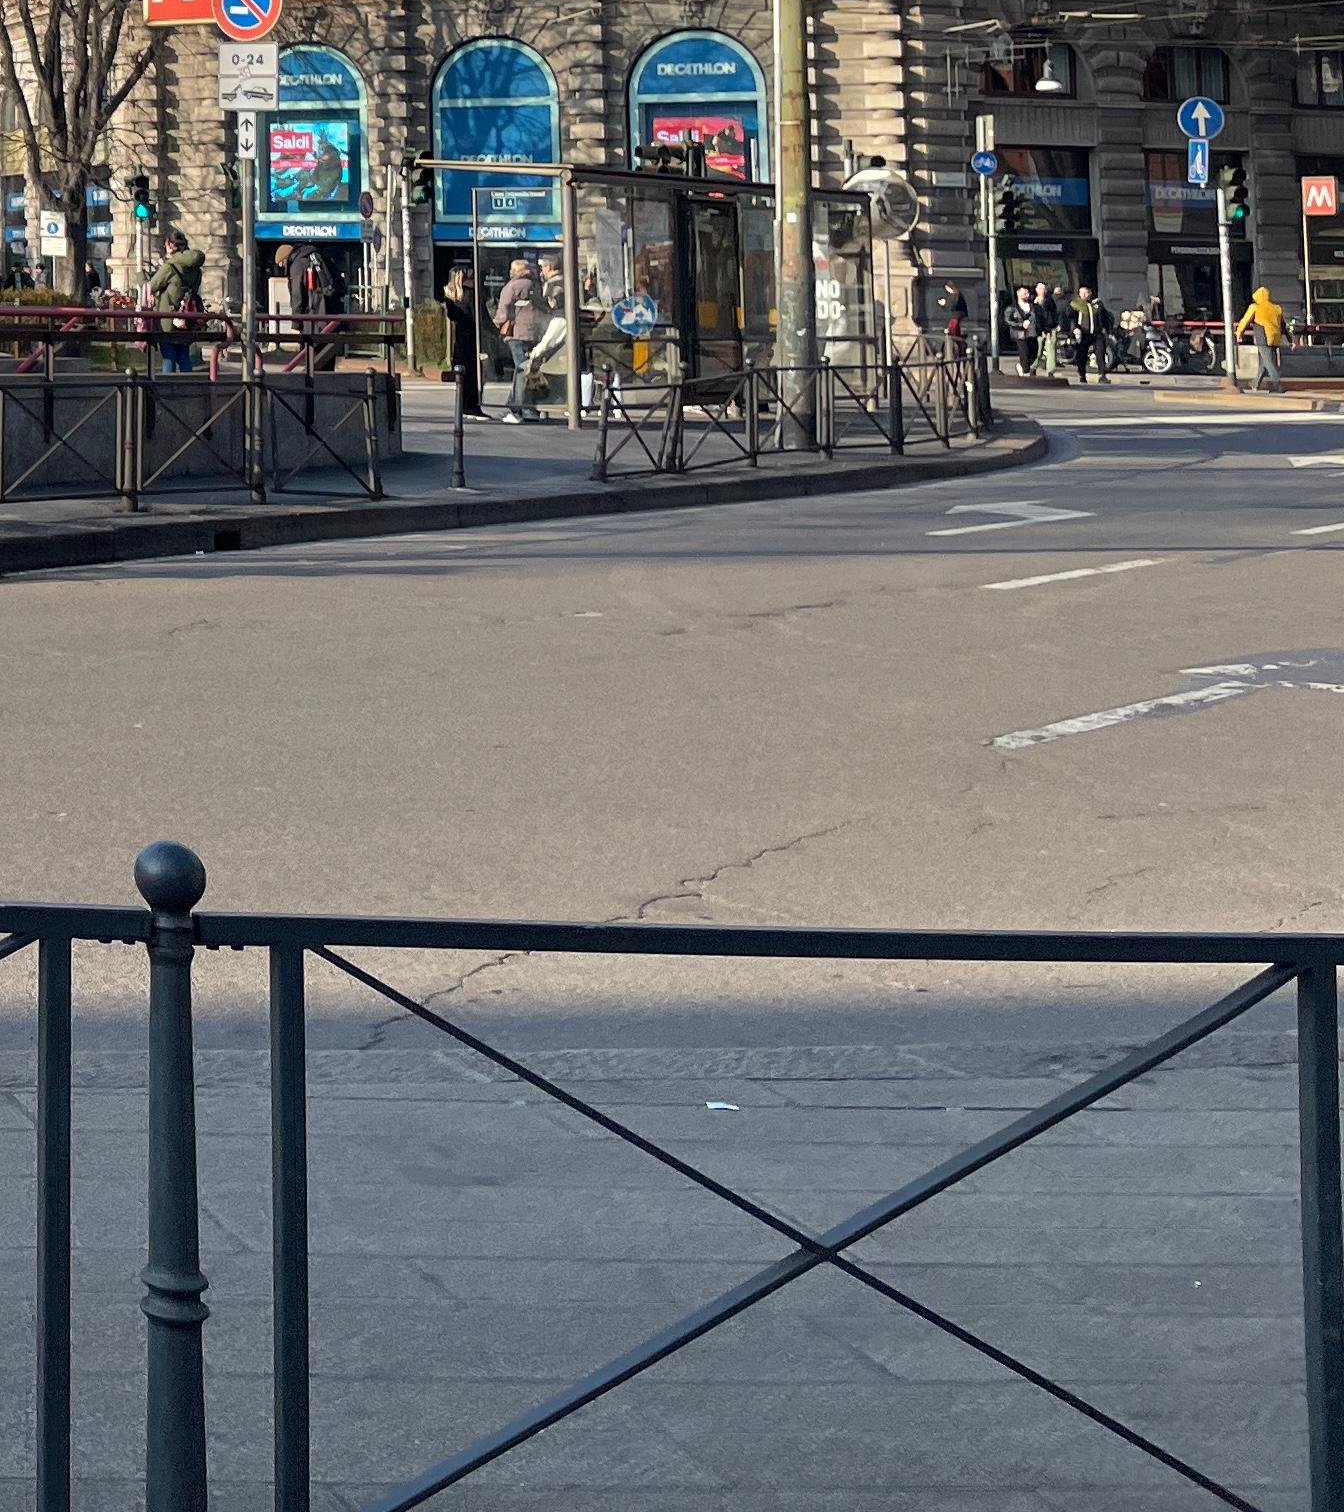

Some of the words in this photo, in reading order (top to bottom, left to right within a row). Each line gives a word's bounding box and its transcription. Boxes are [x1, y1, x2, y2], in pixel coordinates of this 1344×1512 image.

[232, 54, 264, 65] 0-24
[657, 62, 736, 75] DECATHLON
[273, 135, 310, 149] Saldi
[657, 130, 699, 142] Sali
[1307, 185, 1332, 207] M
[283, 226, 336, 236] DECATHLON
